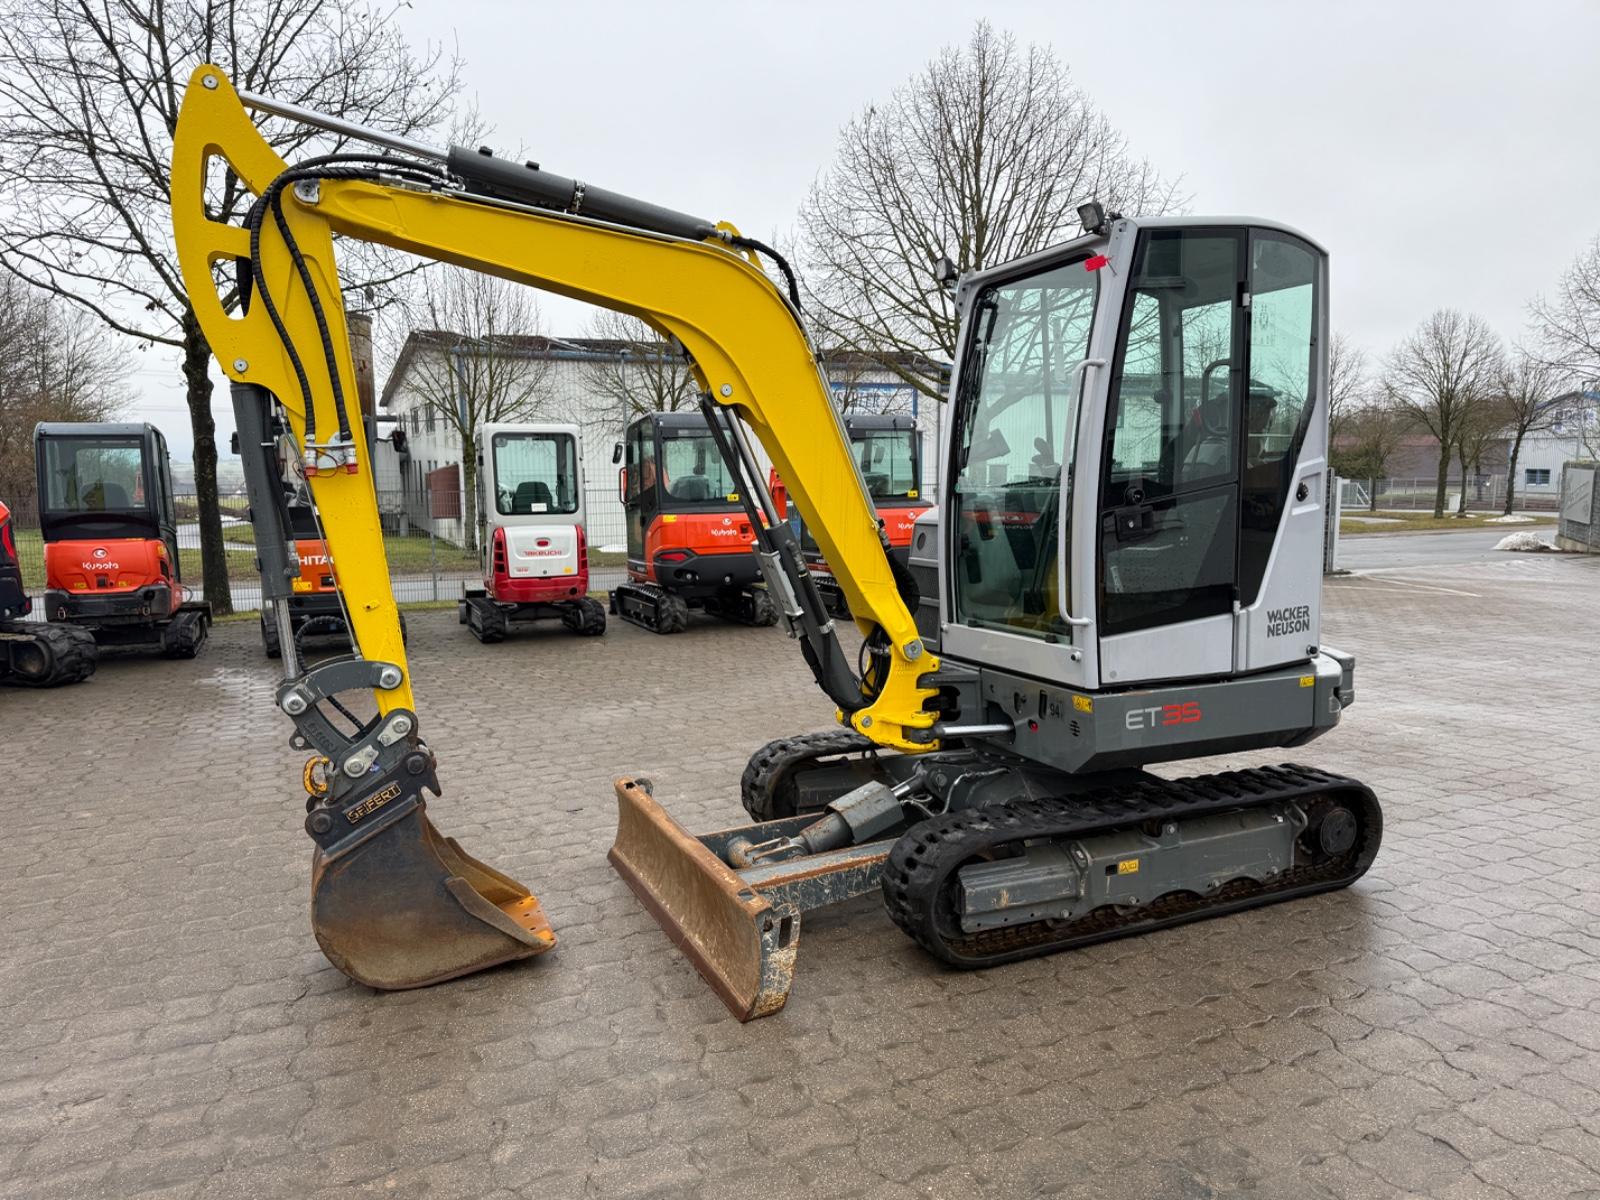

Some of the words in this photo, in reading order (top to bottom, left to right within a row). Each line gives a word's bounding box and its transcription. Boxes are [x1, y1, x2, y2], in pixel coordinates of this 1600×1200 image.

[711, 528, 737, 537] Kubota
[82, 561, 119, 570] Kubota
[1266, 605, 1310, 624] WACKER
[1266, 618, 1310, 639] NEUSON
[1125, 701, 1201, 731] ET35
[346, 783, 400, 822] SEIFERT
